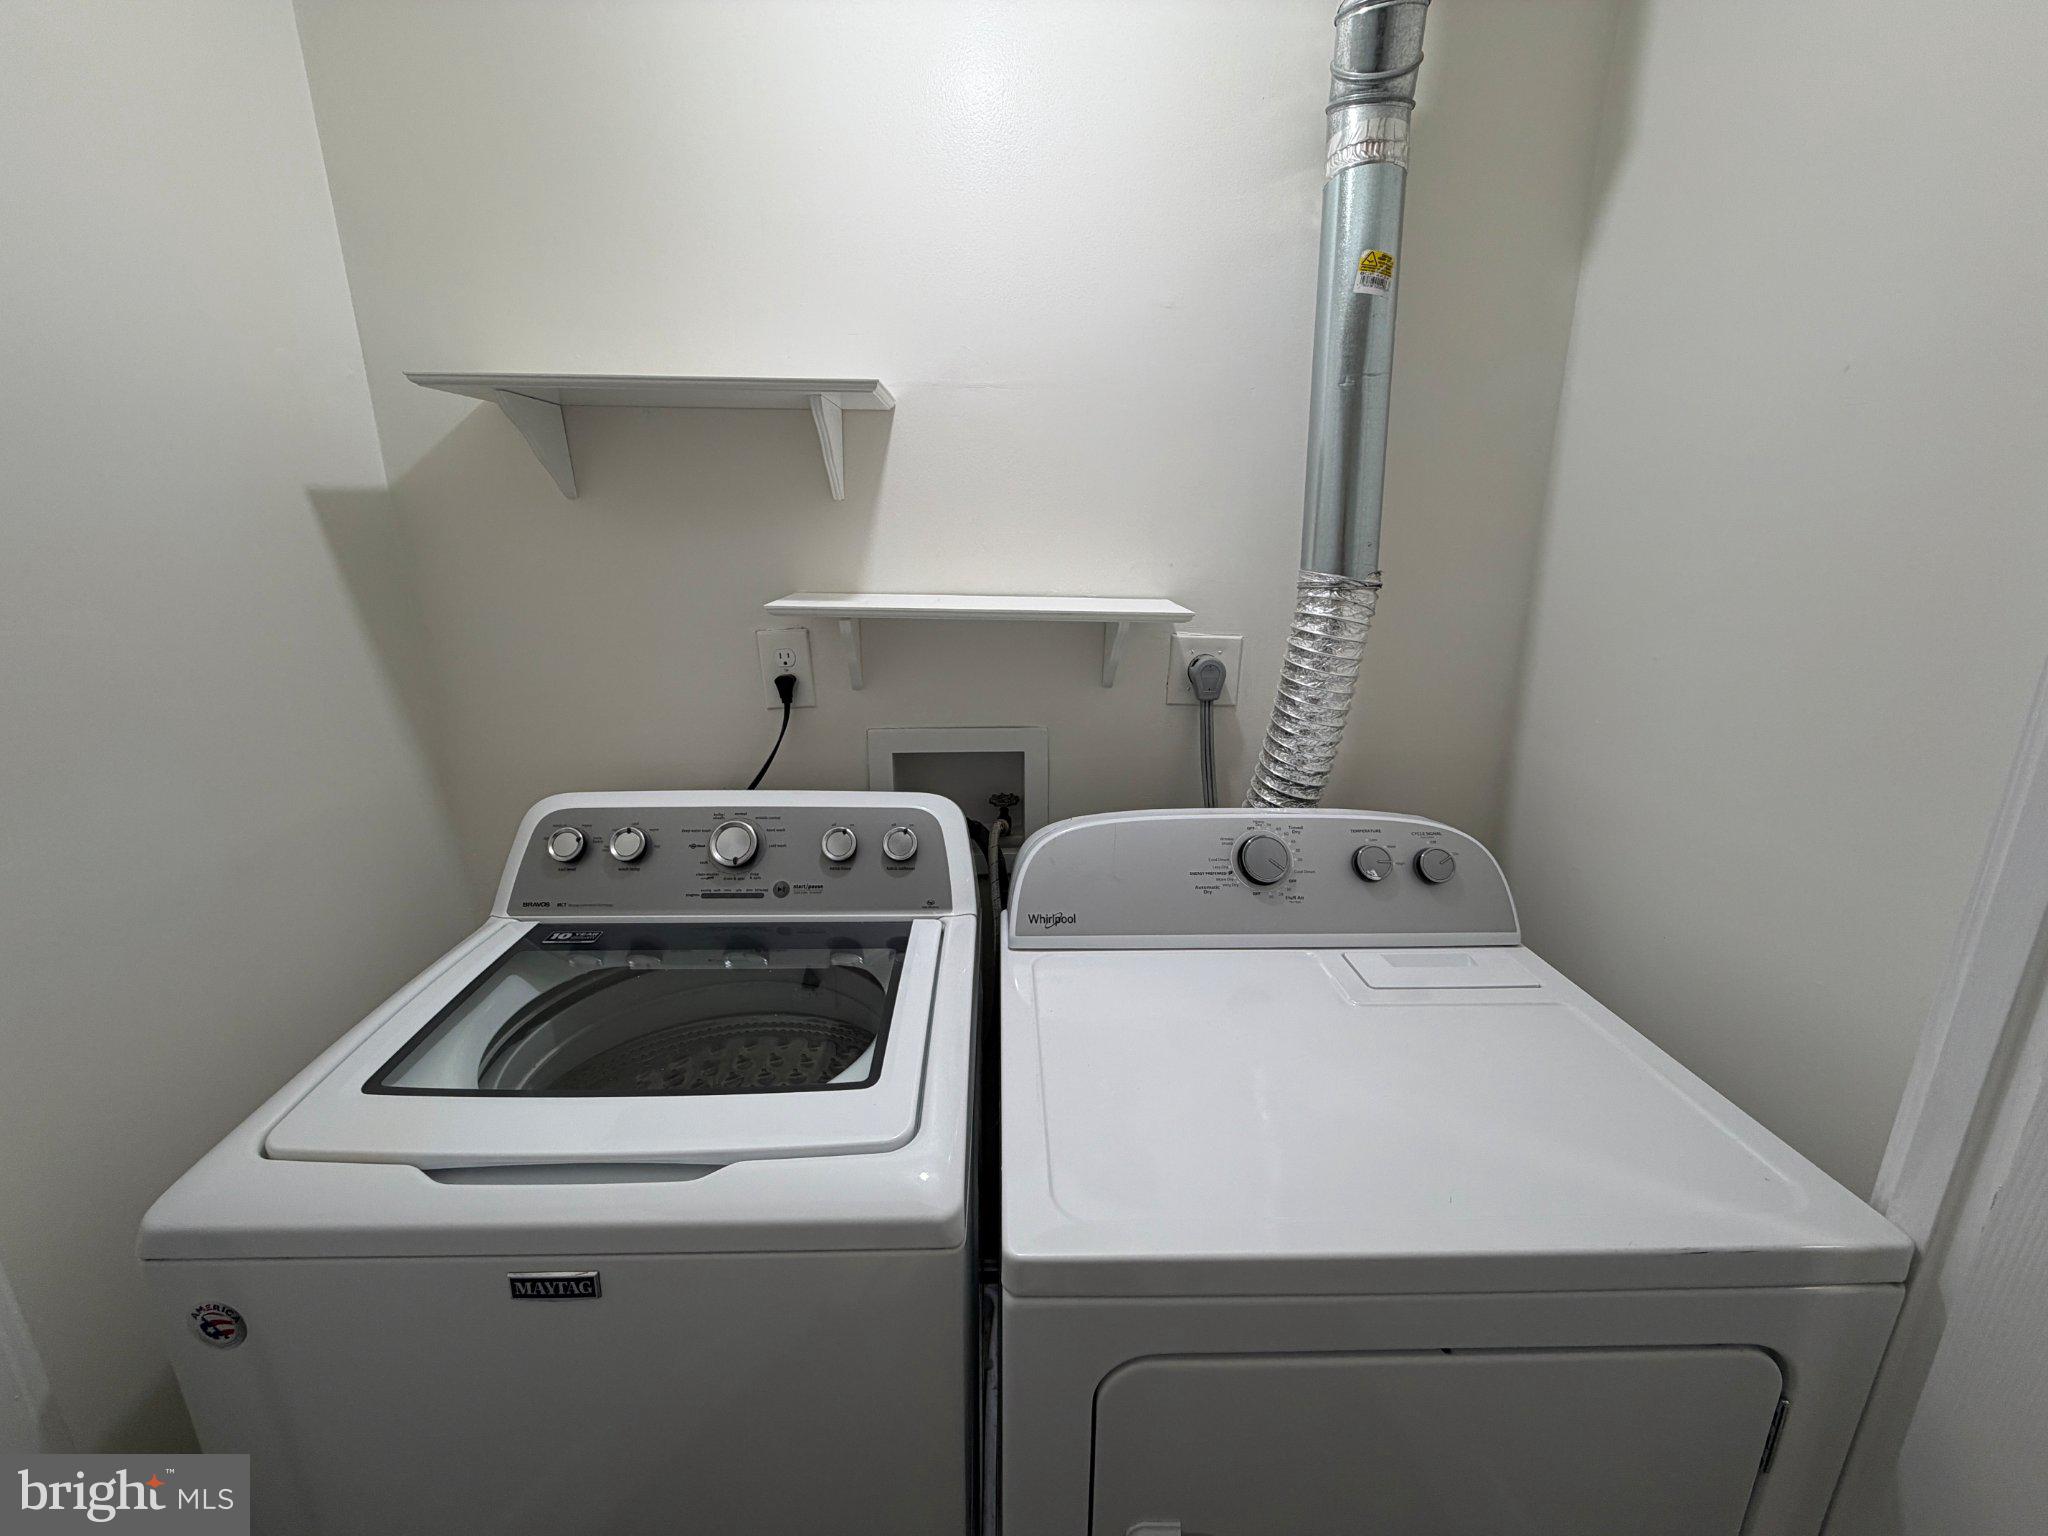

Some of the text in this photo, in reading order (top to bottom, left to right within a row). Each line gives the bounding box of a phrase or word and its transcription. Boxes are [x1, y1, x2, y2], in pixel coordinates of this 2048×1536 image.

[1027, 913, 1076, 927] Whirlpool
[551, 932, 572, 940] 10
[513, 1281, 593, 1295] MAYTAG
[191, 1303, 241, 1324] AMERICA
